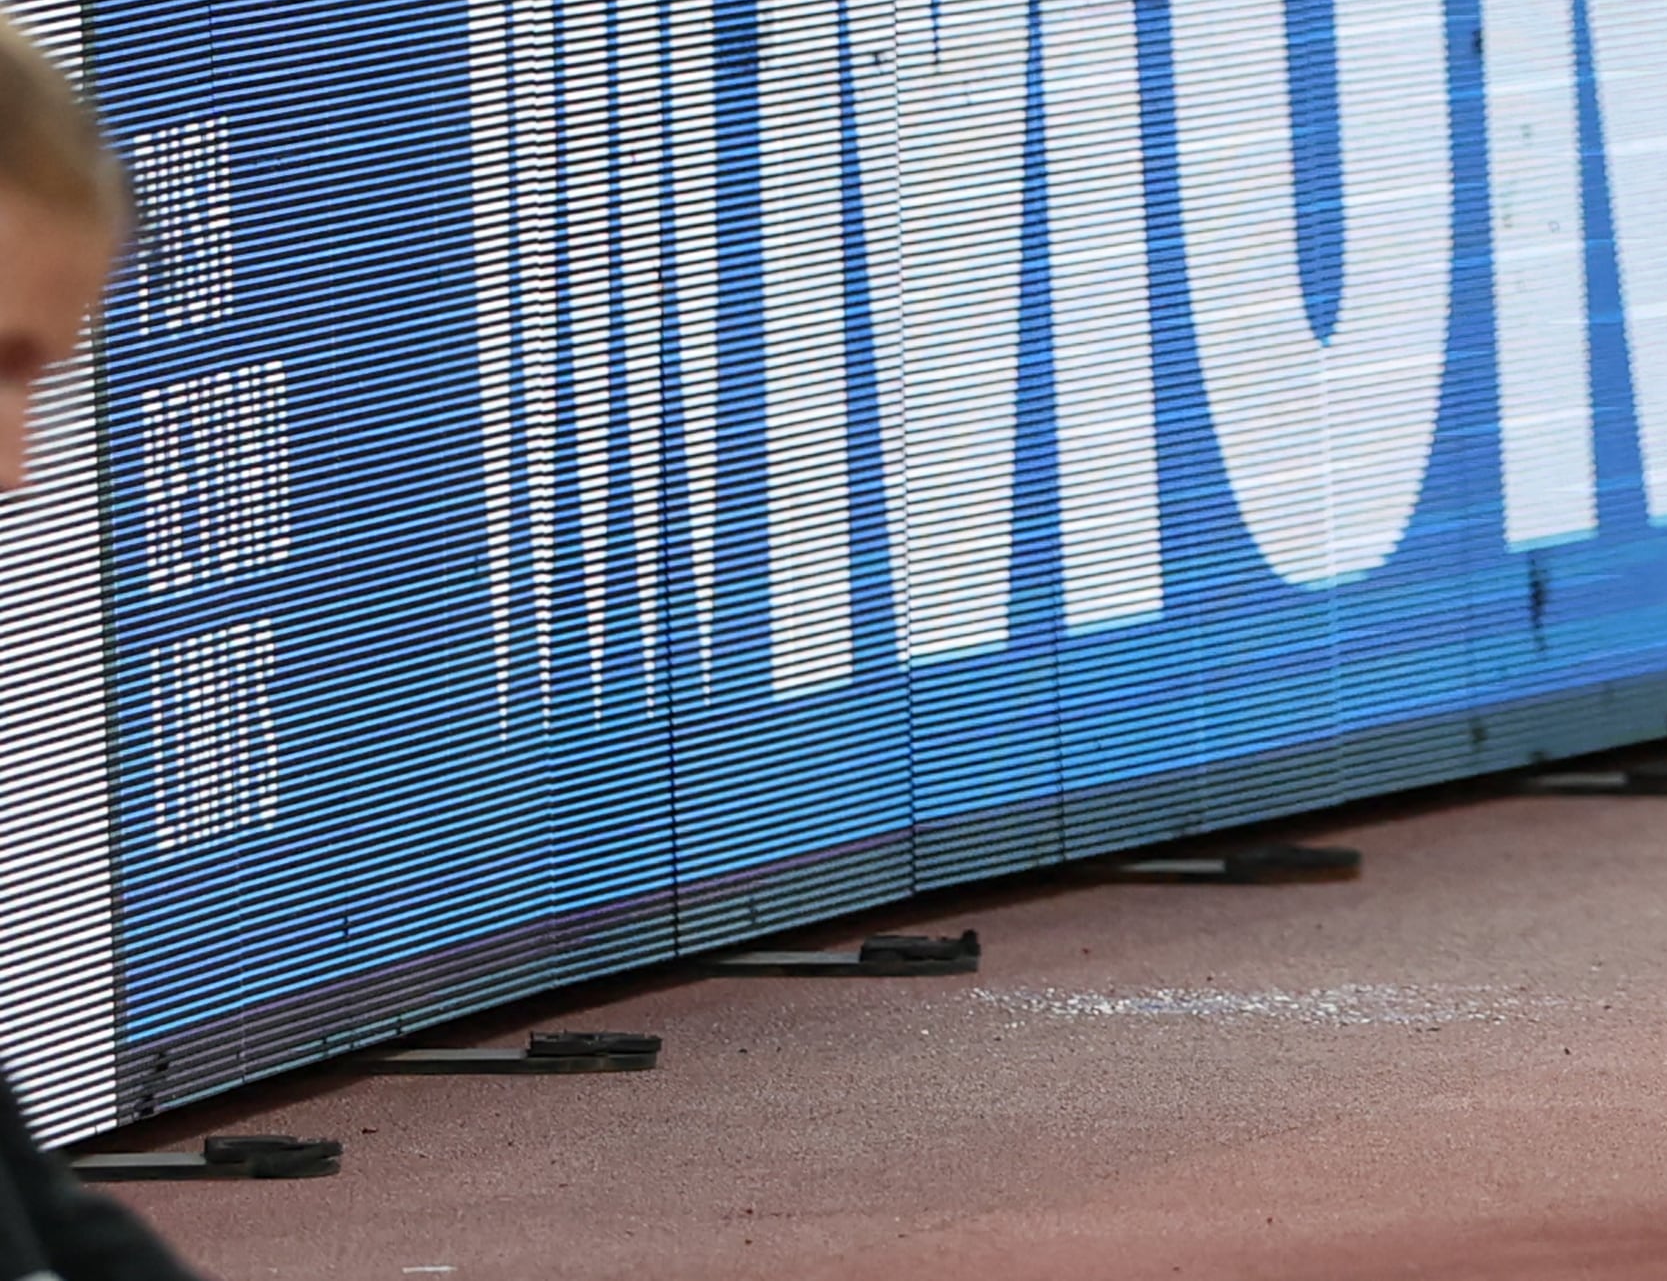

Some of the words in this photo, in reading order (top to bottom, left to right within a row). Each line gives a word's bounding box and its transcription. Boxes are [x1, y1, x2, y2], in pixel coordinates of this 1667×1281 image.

[133, 112, 233, 341] PUSH
[142, 357, 290, 602] BEYOND
[150, 614, 278, 858] LIMITS
